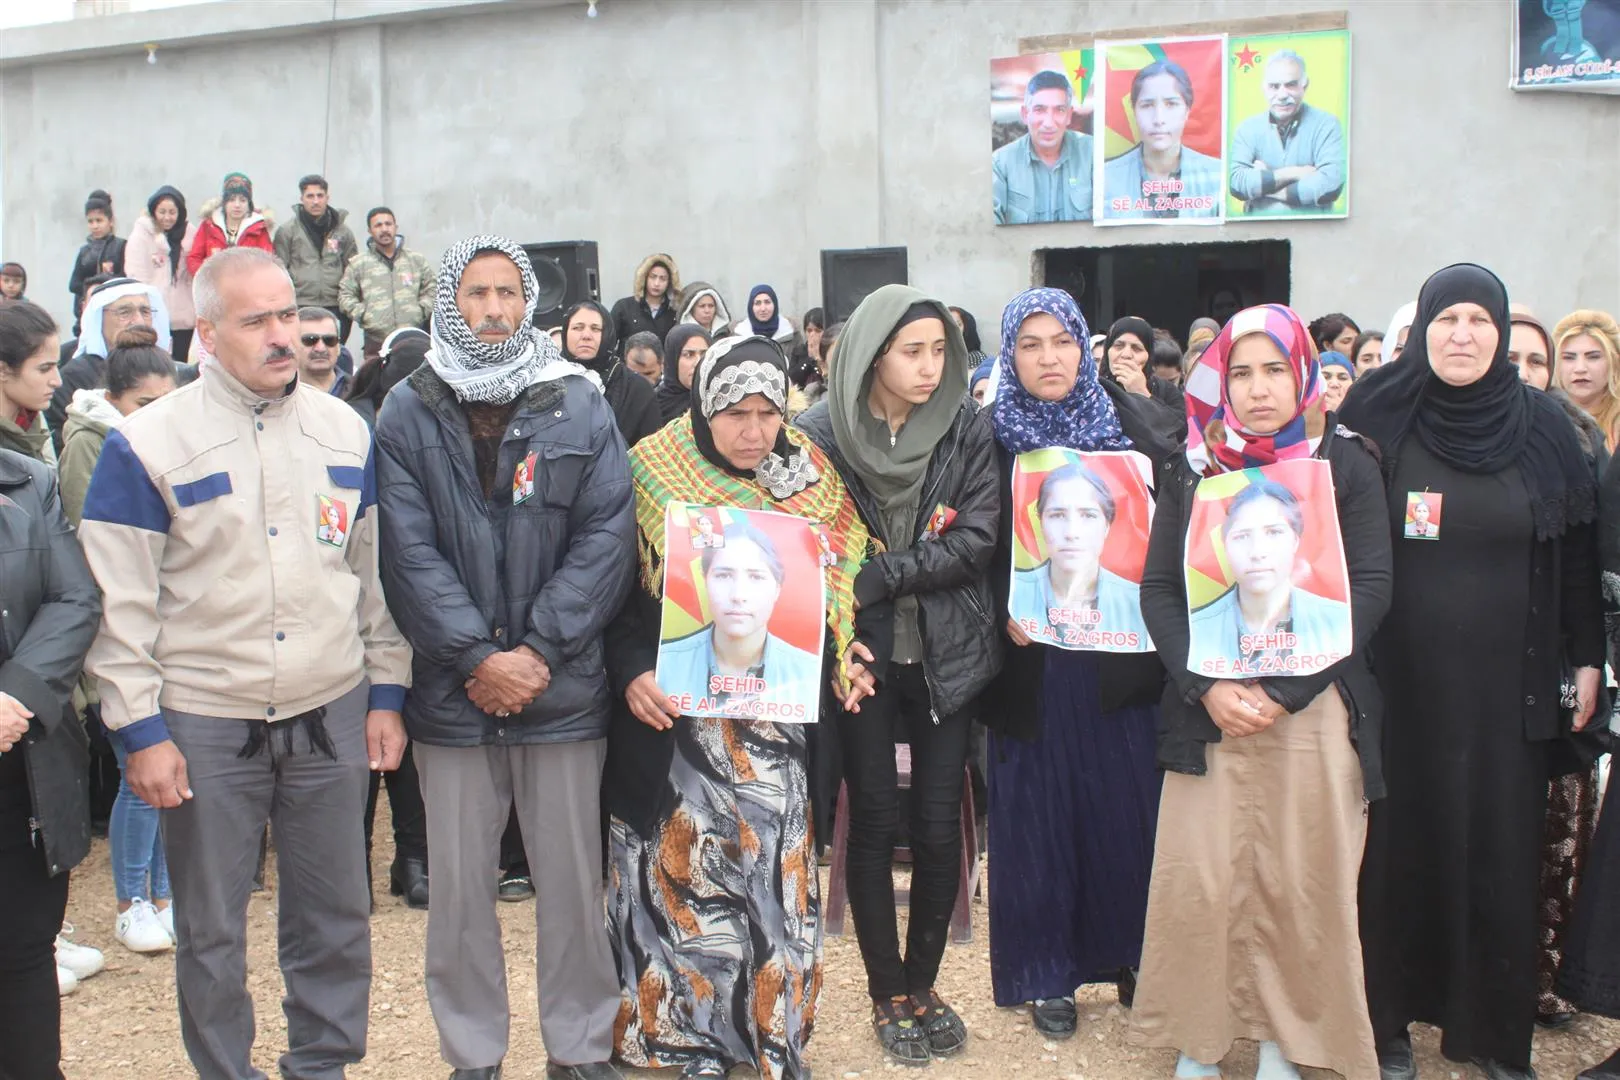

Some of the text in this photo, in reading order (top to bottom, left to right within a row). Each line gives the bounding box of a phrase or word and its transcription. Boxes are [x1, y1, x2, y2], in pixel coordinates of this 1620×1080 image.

[1135, 198, 1152, 211] AL
[1156, 196, 1213, 211] ZAGROS
[1043, 625, 1061, 642] AL
[1064, 629, 1138, 647] ZAGROS
[1231, 658, 1254, 674] AL
[1259, 652, 1341, 673] ZAGROS
[696, 697, 721, 713] AL
[726, 699, 806, 718] ZAGROS
